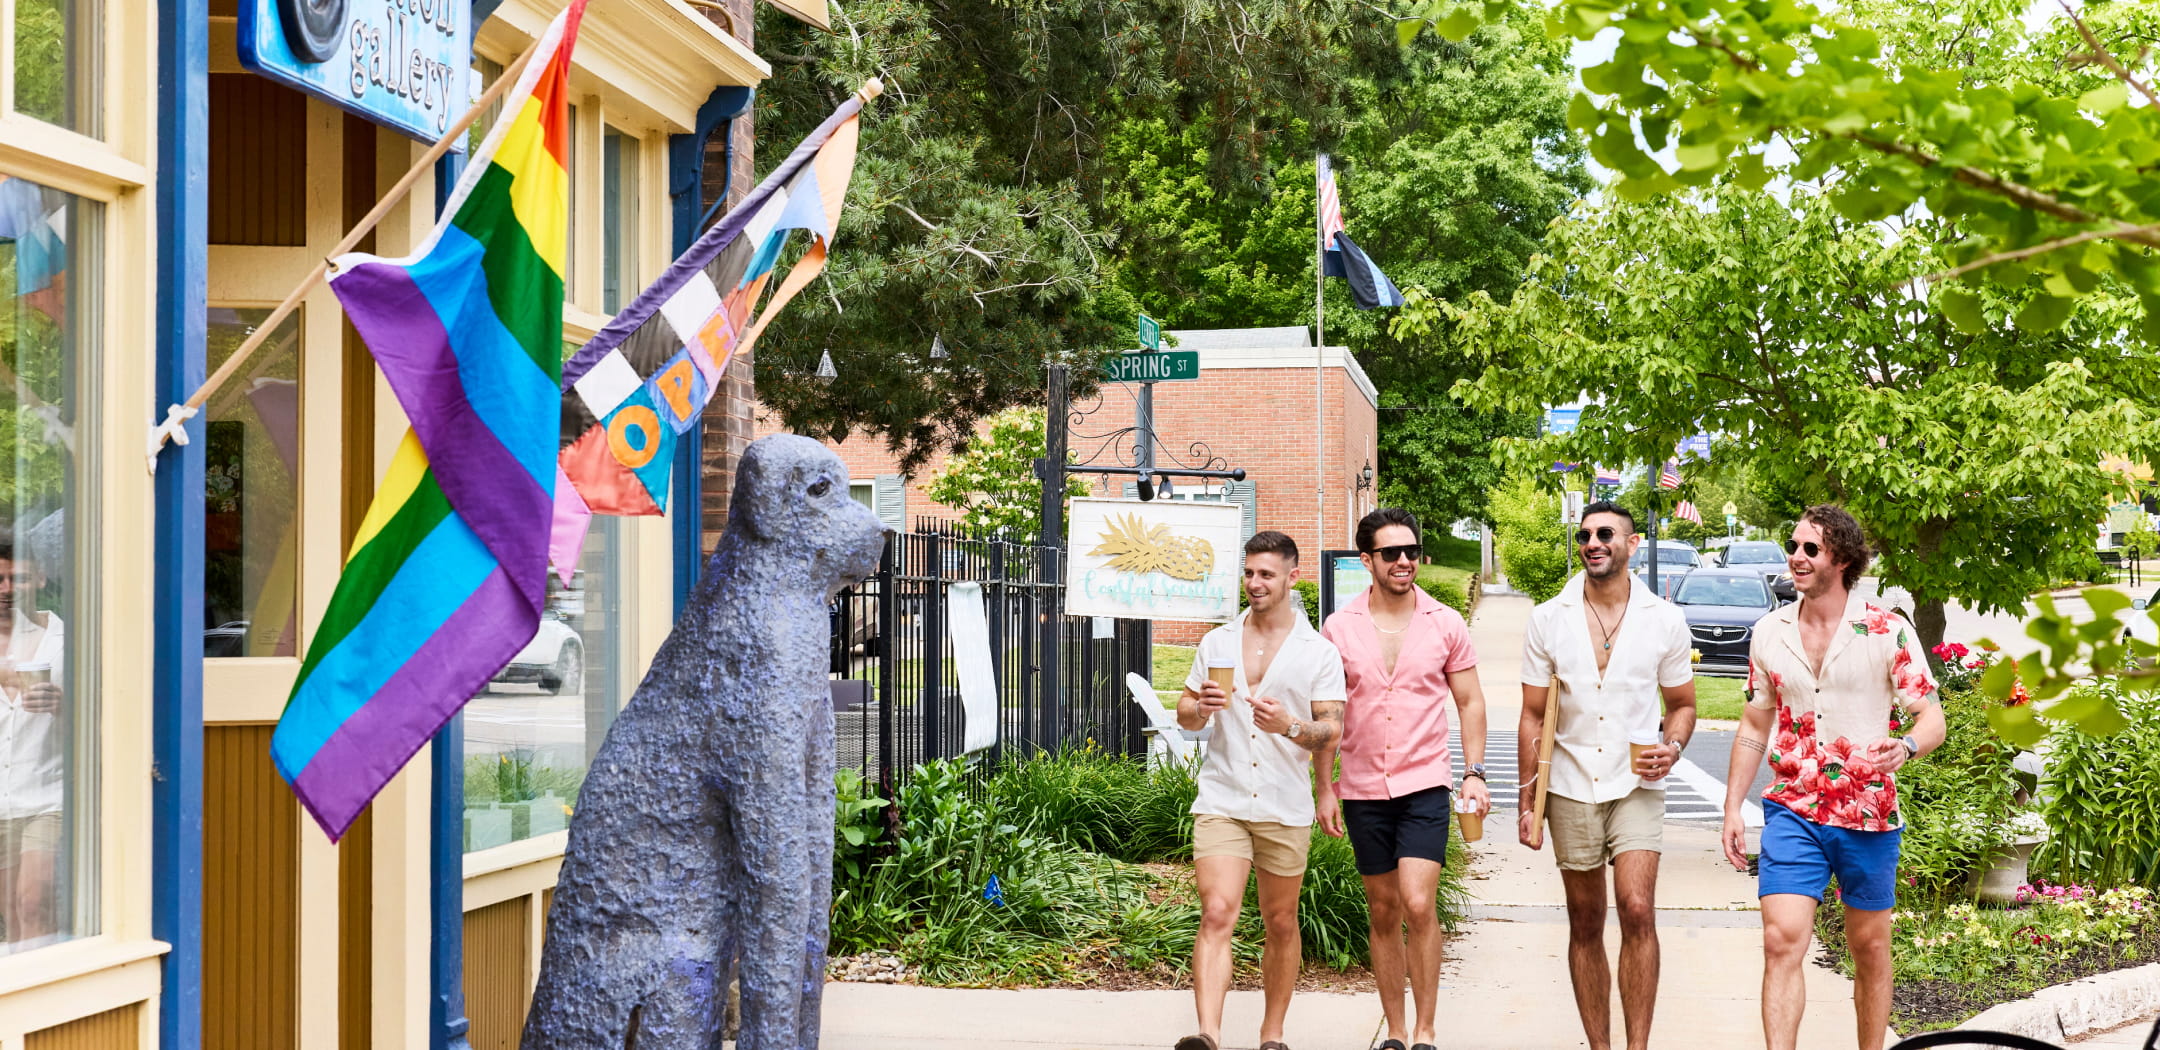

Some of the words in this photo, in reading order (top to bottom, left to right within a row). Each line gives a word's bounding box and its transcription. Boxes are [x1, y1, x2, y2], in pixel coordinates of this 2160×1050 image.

[351, 7, 454, 132] gallery
[1111, 355, 1171, 378] SPRING
[1177, 359, 1188, 372] ST
[1076, 569, 1158, 607] Coastal
[1161, 570, 1227, 610] Society
